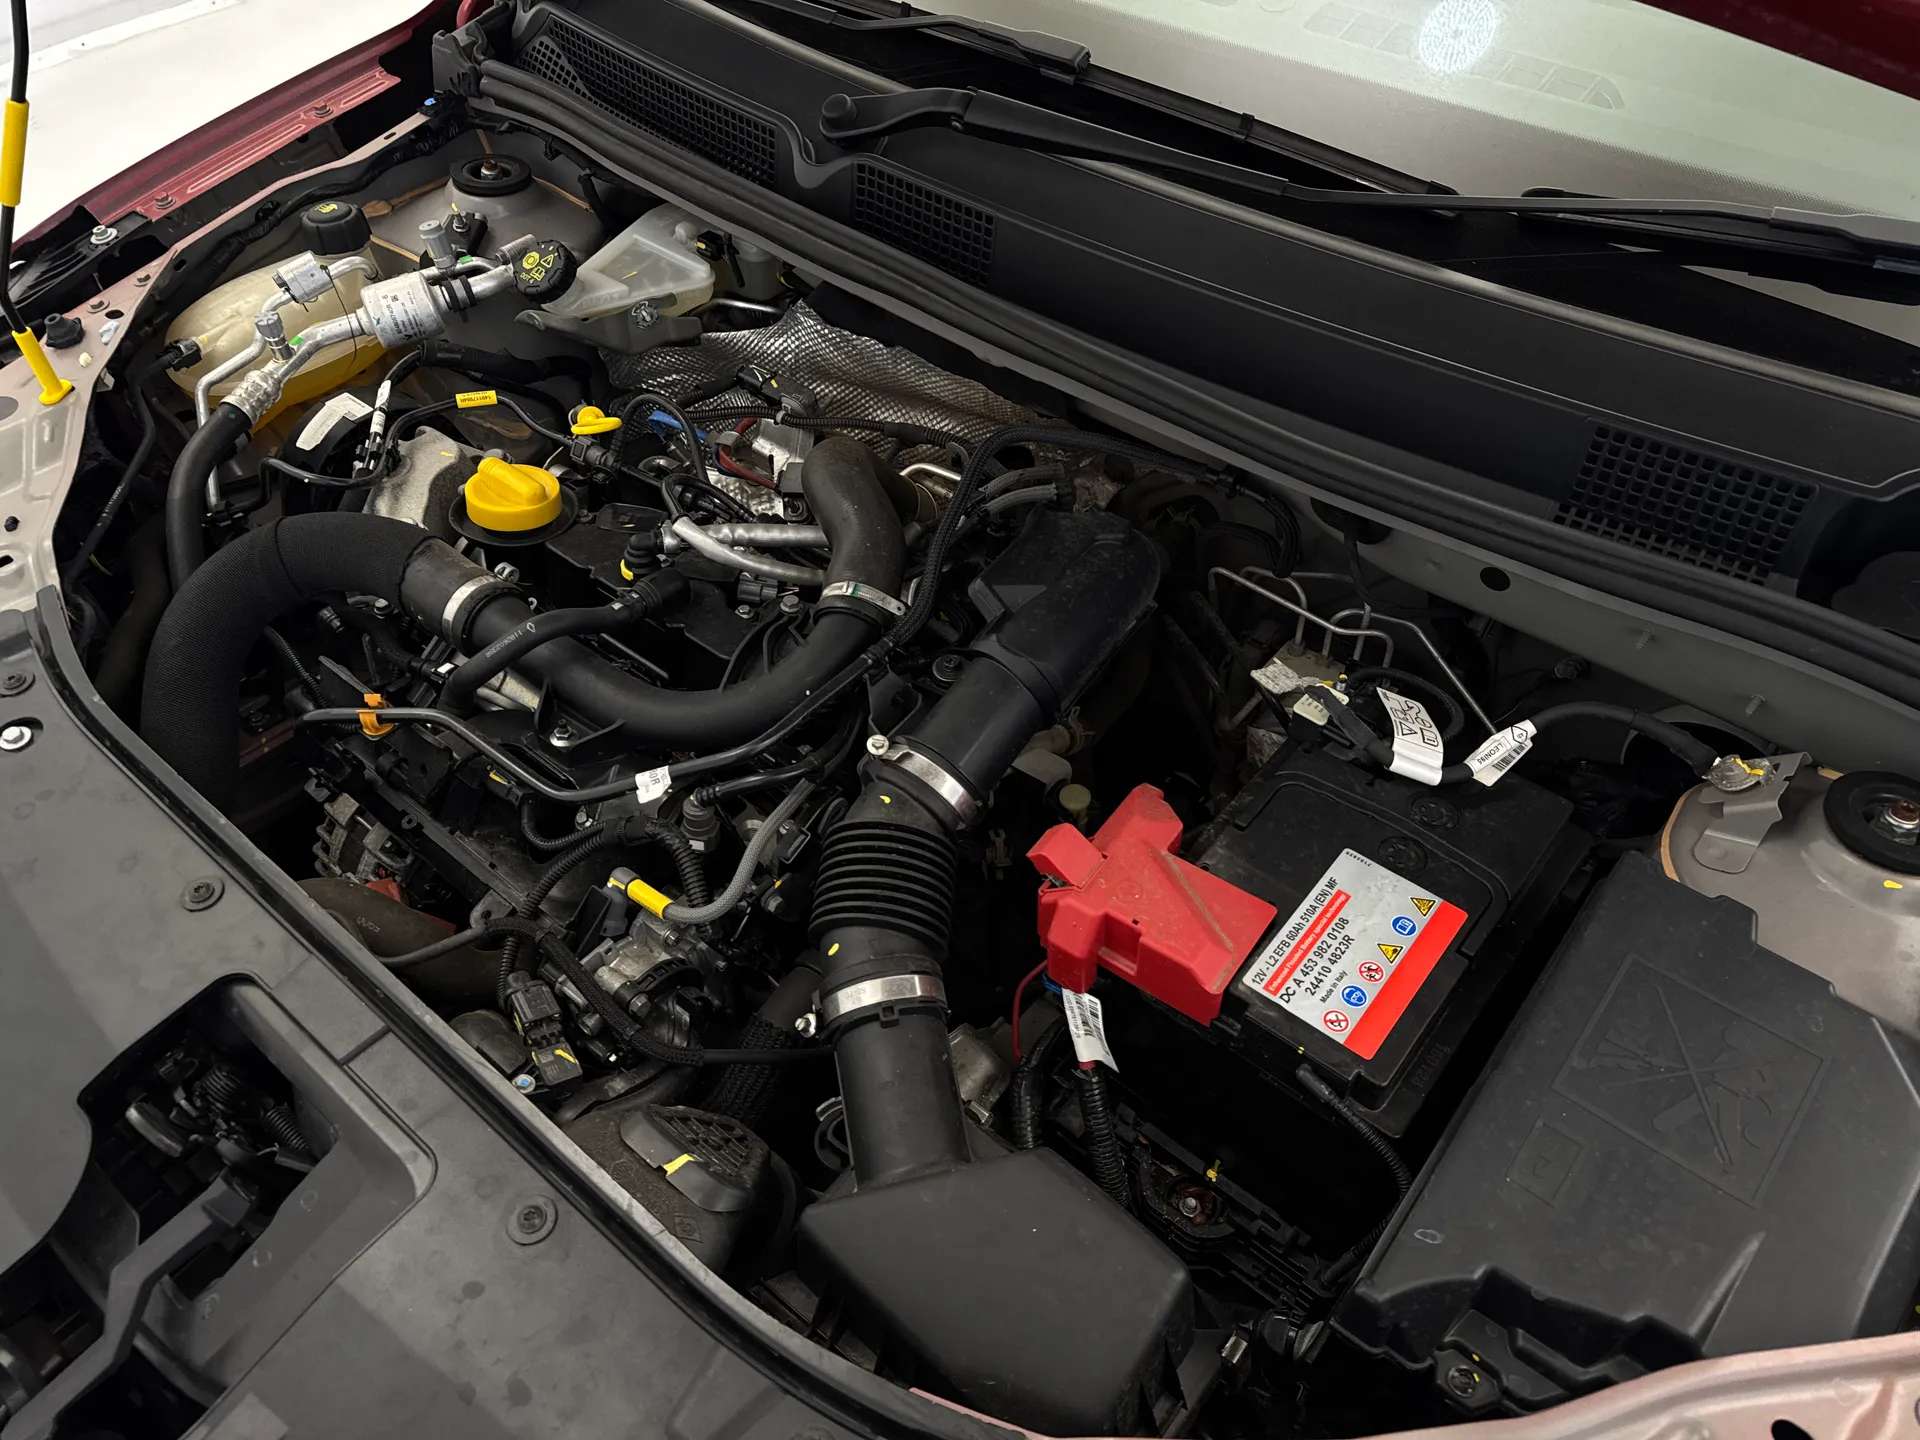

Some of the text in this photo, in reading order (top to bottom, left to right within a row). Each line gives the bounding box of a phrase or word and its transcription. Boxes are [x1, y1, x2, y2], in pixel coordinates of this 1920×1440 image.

[1250, 968, 1268, 987] 12V
[1265, 954, 1280, 968] L2
[1273, 938, 1292, 958] EFB
[1286, 920, 1306, 942] 60Ah
[1300, 902, 1320, 924] 510A
[1313, 887, 1333, 908] (EN)
[1325, 876, 1340, 891] MF
[1279, 915, 1350, 1004] DC A 453 982 0108
[1304, 934, 1355, 997] 24410 4823R
[1319, 987, 1335, 1004] Made
[1335, 969, 1349, 984] Italy
